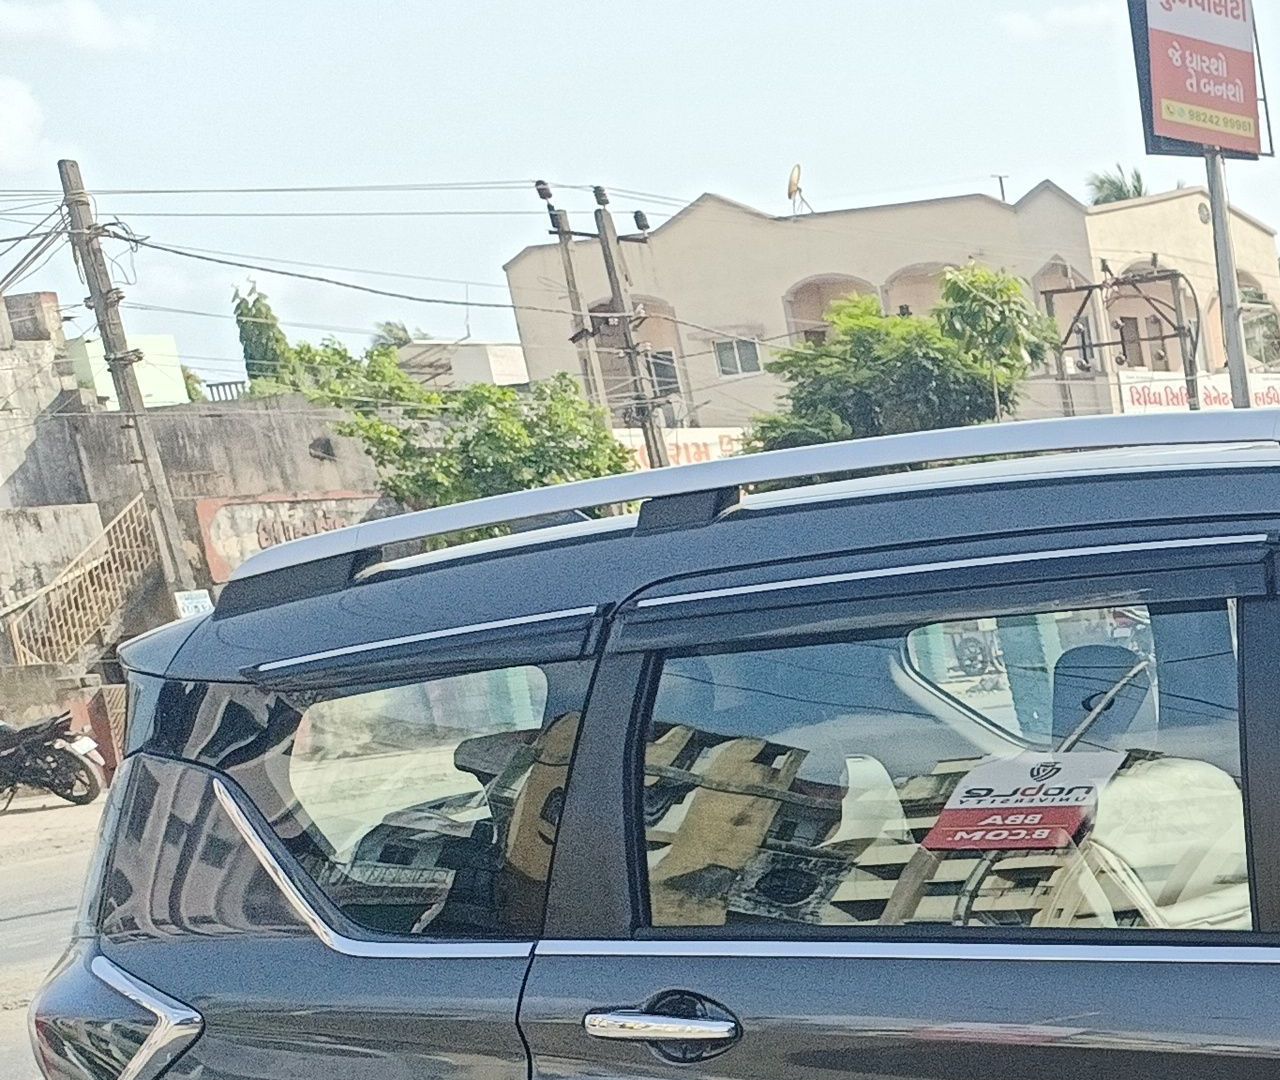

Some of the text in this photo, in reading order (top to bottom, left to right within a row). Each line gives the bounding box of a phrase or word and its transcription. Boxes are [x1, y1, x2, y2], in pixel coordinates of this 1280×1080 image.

[1168, 41, 1182, 67] જે
[1201, 78, 1245, 103] બનશો
[1188, 109, 1221, 126] 98242
